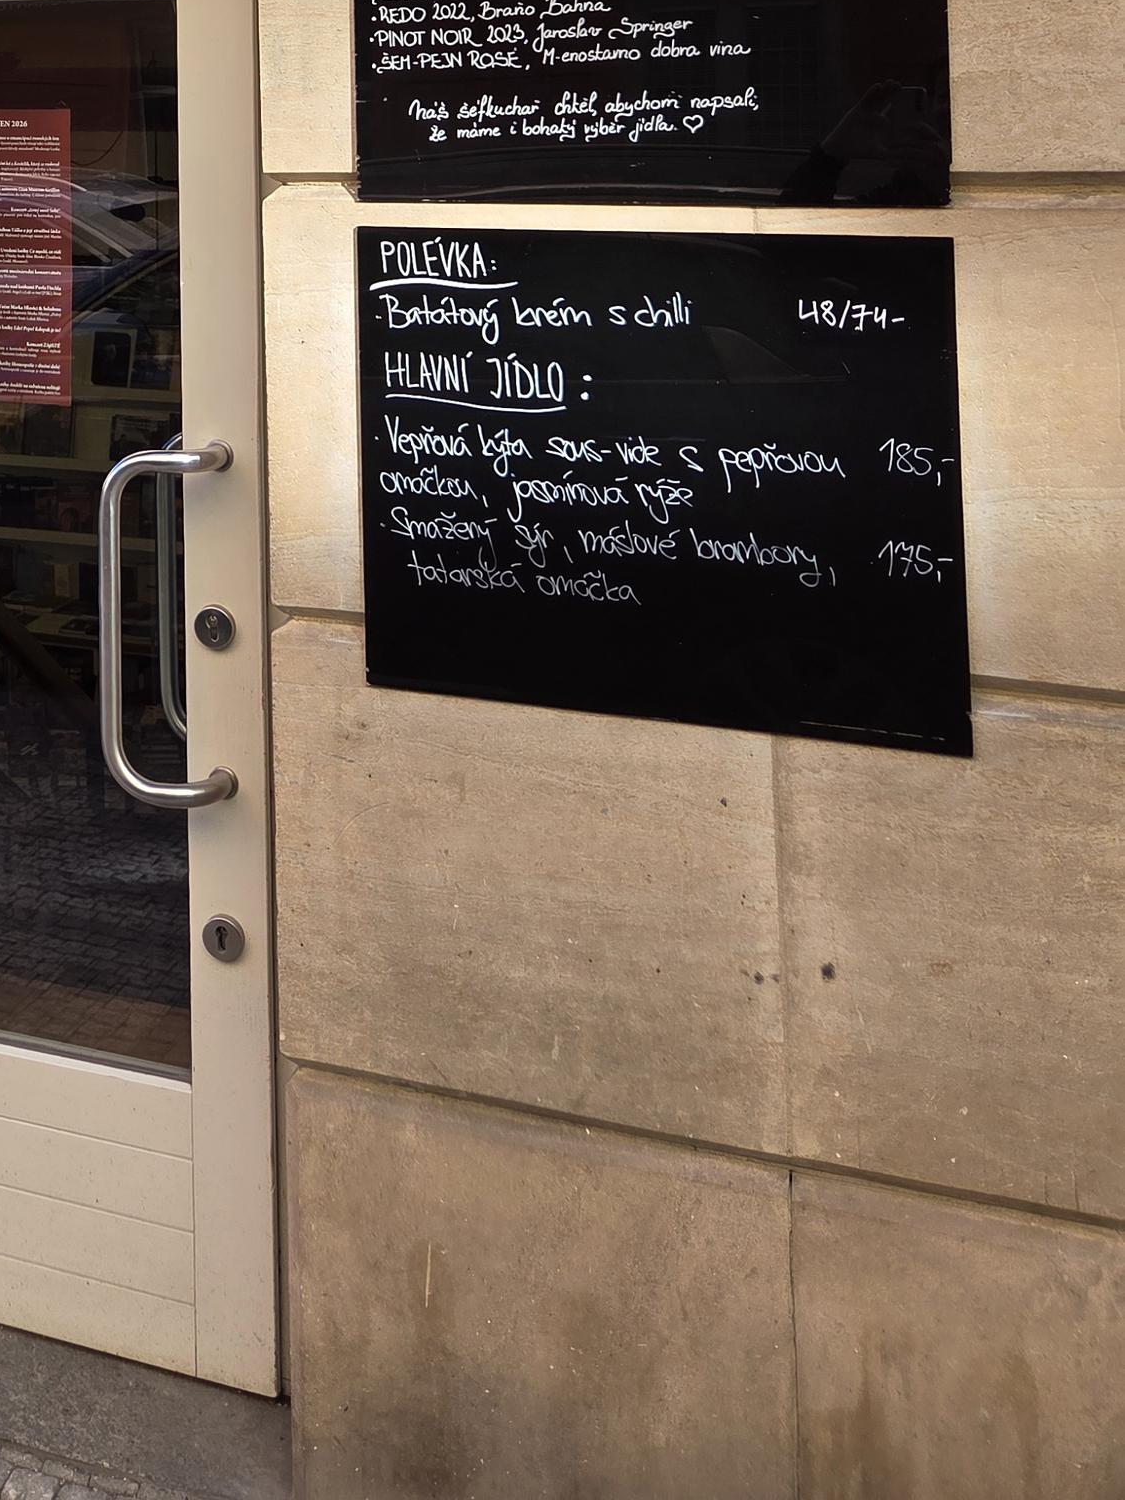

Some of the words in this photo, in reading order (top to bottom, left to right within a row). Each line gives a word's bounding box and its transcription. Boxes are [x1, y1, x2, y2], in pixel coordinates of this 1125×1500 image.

[374, 29, 426, 48] PINOT
[430, 27, 483, 47] NOIR
[486, 24, 528, 45] 2023,
[532, 18, 603, 53] Jaroslav
[608, 16, 694, 40] Springer
[379, 6, 426, 24] REDO
[432, 3, 475, 22] 2022,
[376, 50, 463, 73] ŠEM-PEJN
[650, 39, 701, 59] dobra
[408, 98, 449, 121] Náš
[456, 94, 540, 122] šéfkuchař
[604, 90, 681, 122] abychom
[456, 122, 501, 139] máme
[509, 121, 518, 136] i
[522, 116, 576, 142] bohatý
[584, 117, 626, 142] výběr
[380, 237, 497, 278] POLÉVKA:
[380, 294, 499, 345] Batátový
[512, 297, 592, 327] krém
[608, 304, 627, 326] s
[634, 291, 692, 327] chilli
[385, 351, 473, 394] HLAVNÍ
[384, 414, 472, 464] Vepřová
[477, 424, 533, 477] kýta
[719, 443, 846, 493] pepřovou
[879, 438, 955, 487] 185,-
[380, 465, 488, 508] omáčkou,
[507, 470, 629, 523] jasmínová
[635, 478, 693, 525] rýže
[391, 506, 498, 572] Smažený
[578, 520, 680, 559] máslové
[878, 540, 953, 583] 175,-
[407, 550, 525, 593] tatarská
[536, 570, 642, 605] omáčka
